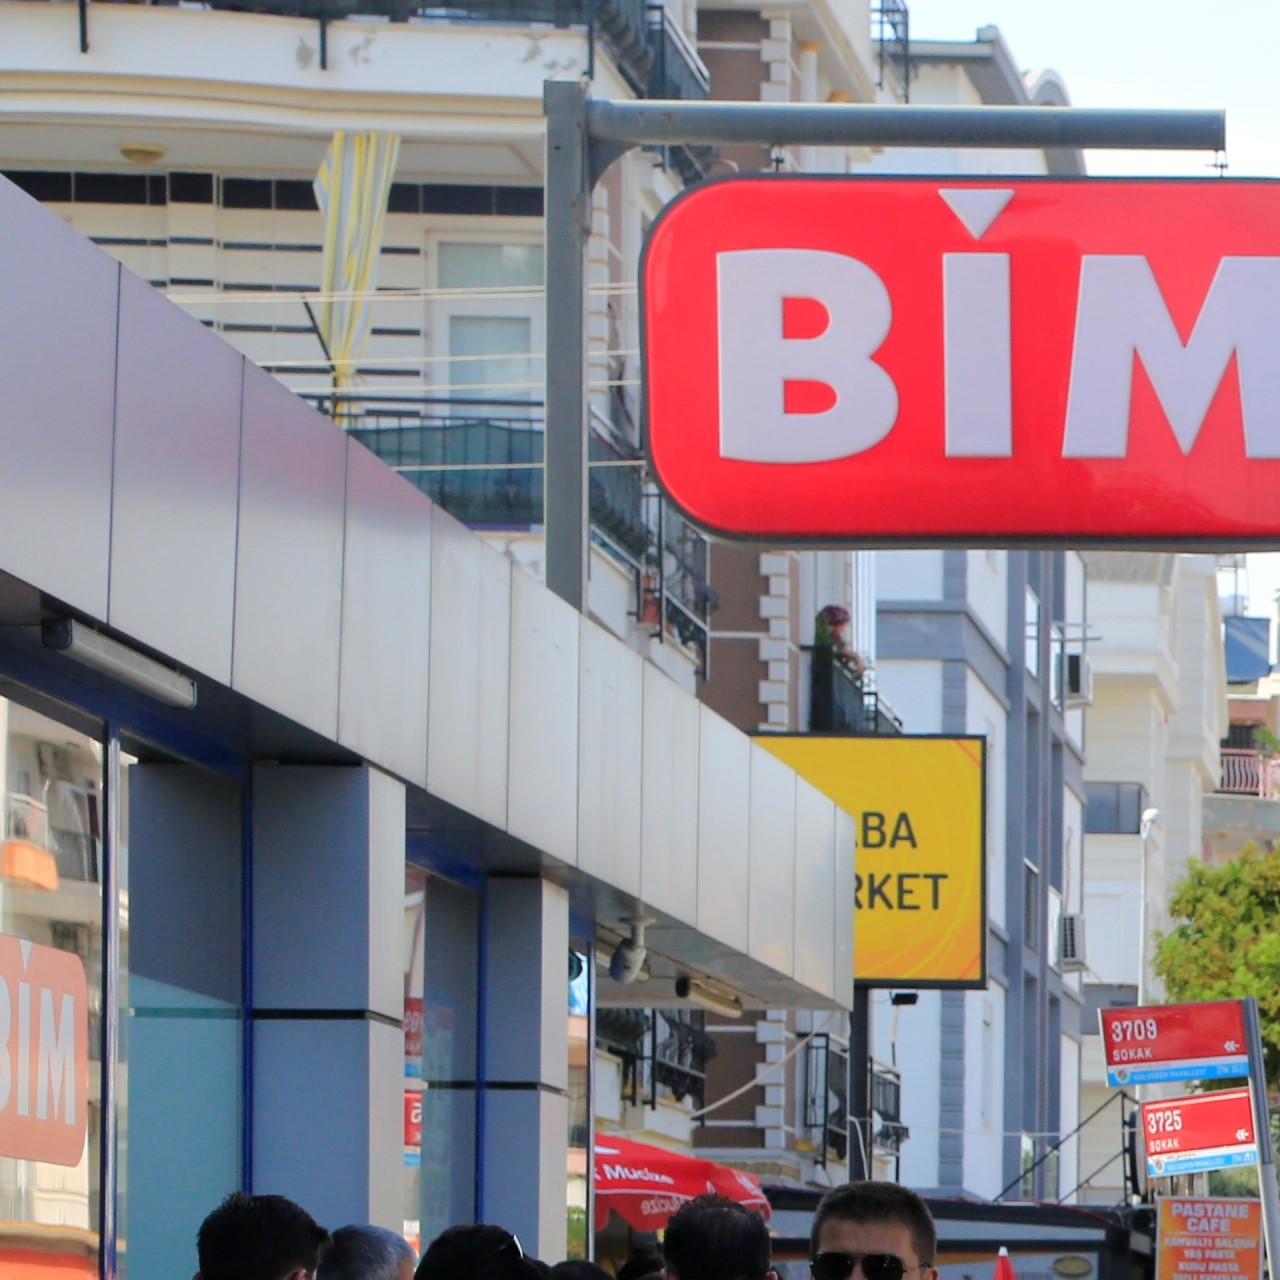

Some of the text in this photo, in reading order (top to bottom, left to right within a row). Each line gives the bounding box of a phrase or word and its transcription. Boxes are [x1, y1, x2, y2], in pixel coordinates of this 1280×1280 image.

[855, 811, 917, 848] BA
[1111, 1018, 1157, 1043] 3709
[1112, 1048, 1152, 1061] SOKAK
[1147, 1109, 1182, 1134] 3725
[1149, 1138, 1179, 1152] SOKAK
[1171, 1203, 1249, 1218] PASTANE
[1186, 1218, 1230, 1232] CAFE
